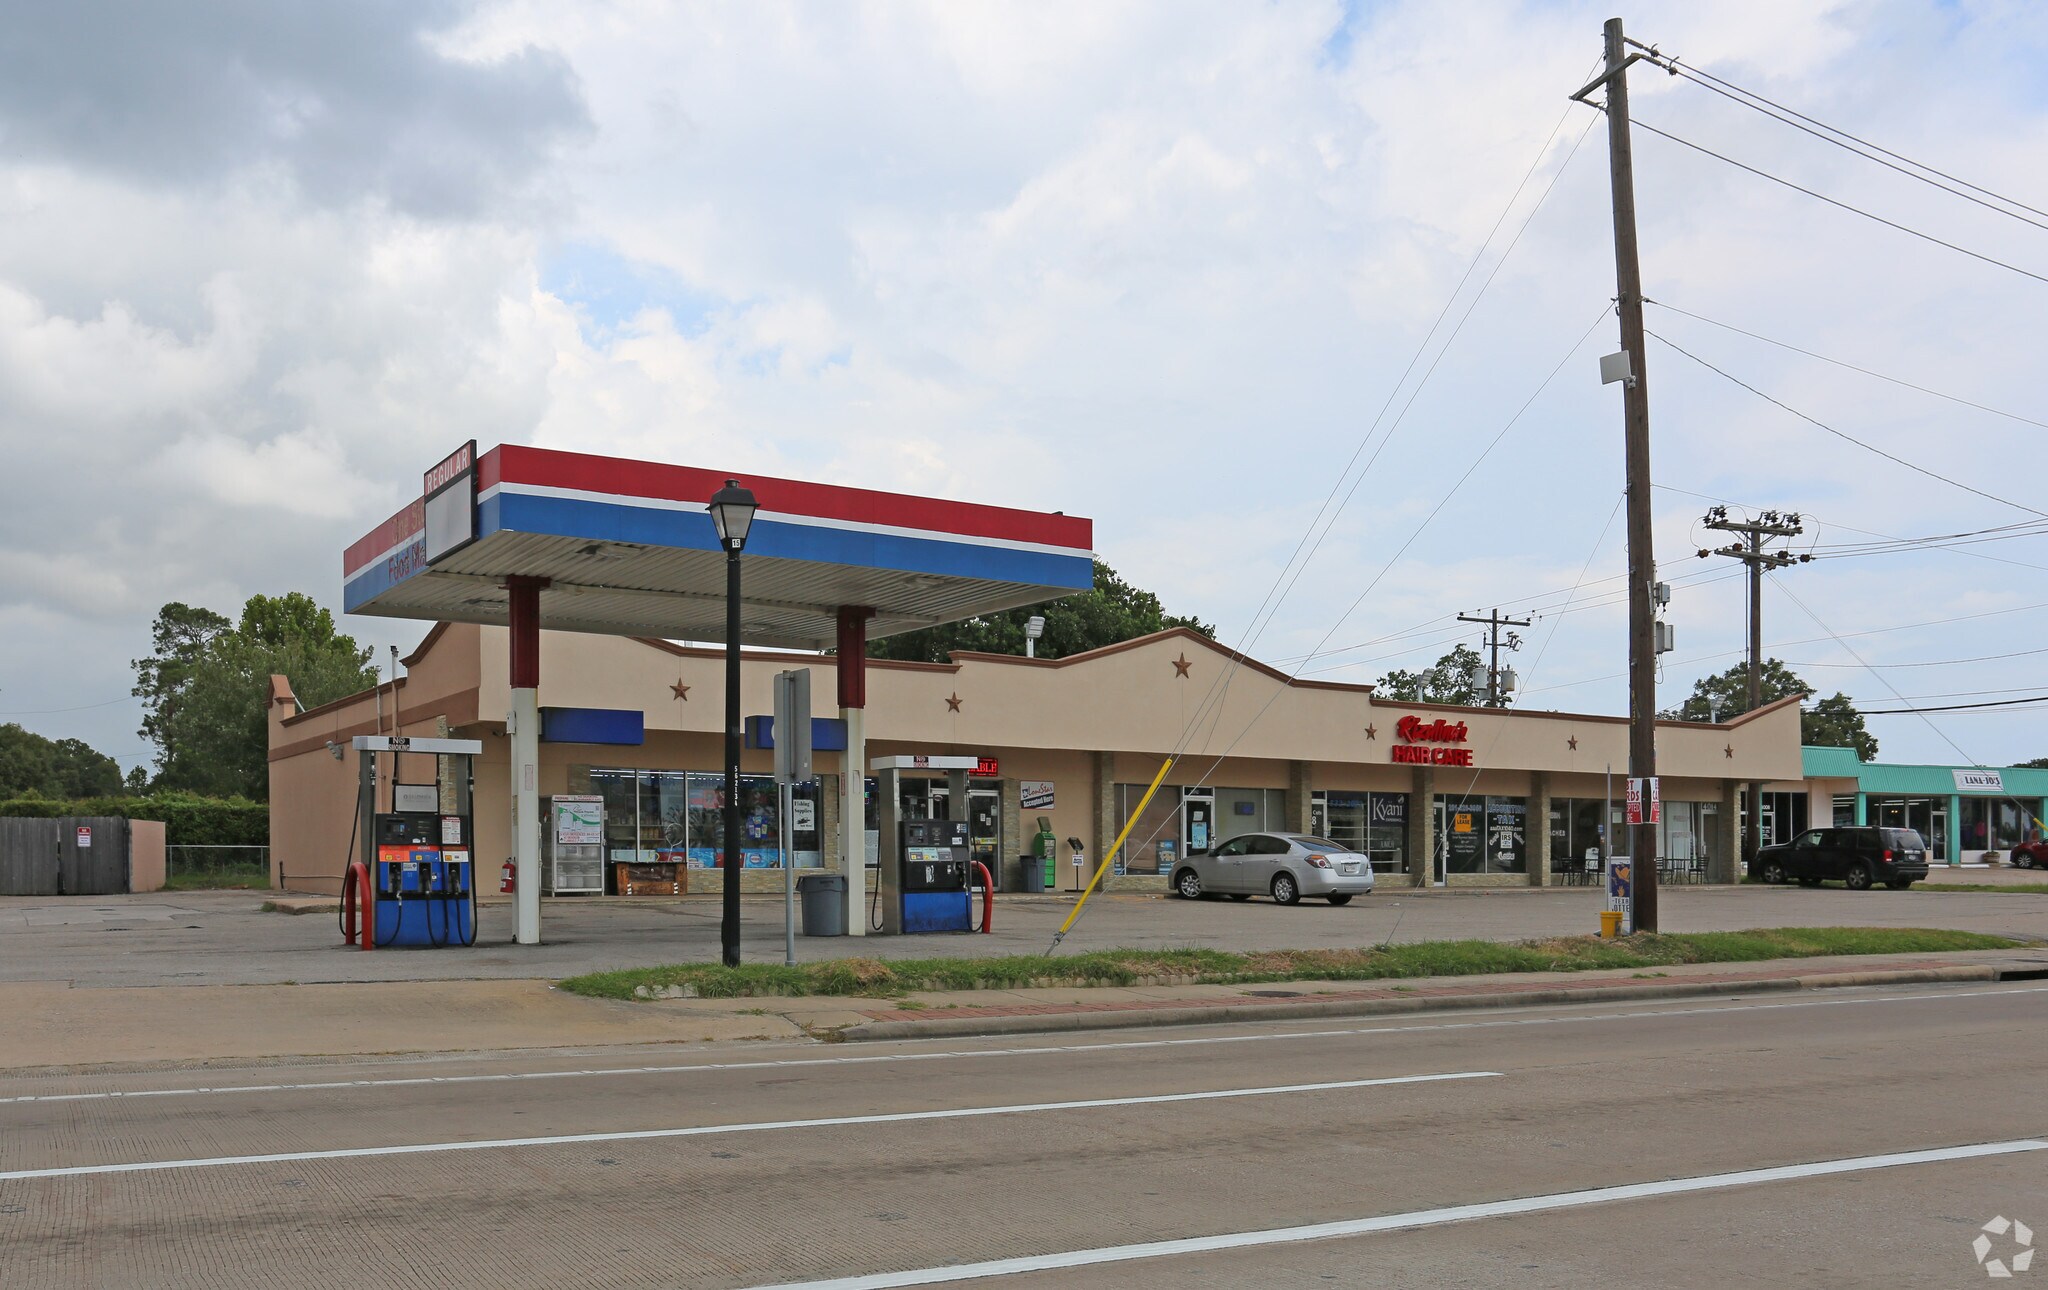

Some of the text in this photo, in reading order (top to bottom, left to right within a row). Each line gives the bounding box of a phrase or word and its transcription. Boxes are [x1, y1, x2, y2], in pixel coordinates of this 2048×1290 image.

[427, 448, 468, 493] REGULAR
[732, 539, 740, 547] 15
[388, 550, 410, 582] Food
[1392, 745, 1473, 767] HAIR CARE
[1964, 775, 2000, 785] LANA-JO'S
[1023, 795, 1054, 807] Accepted Here
